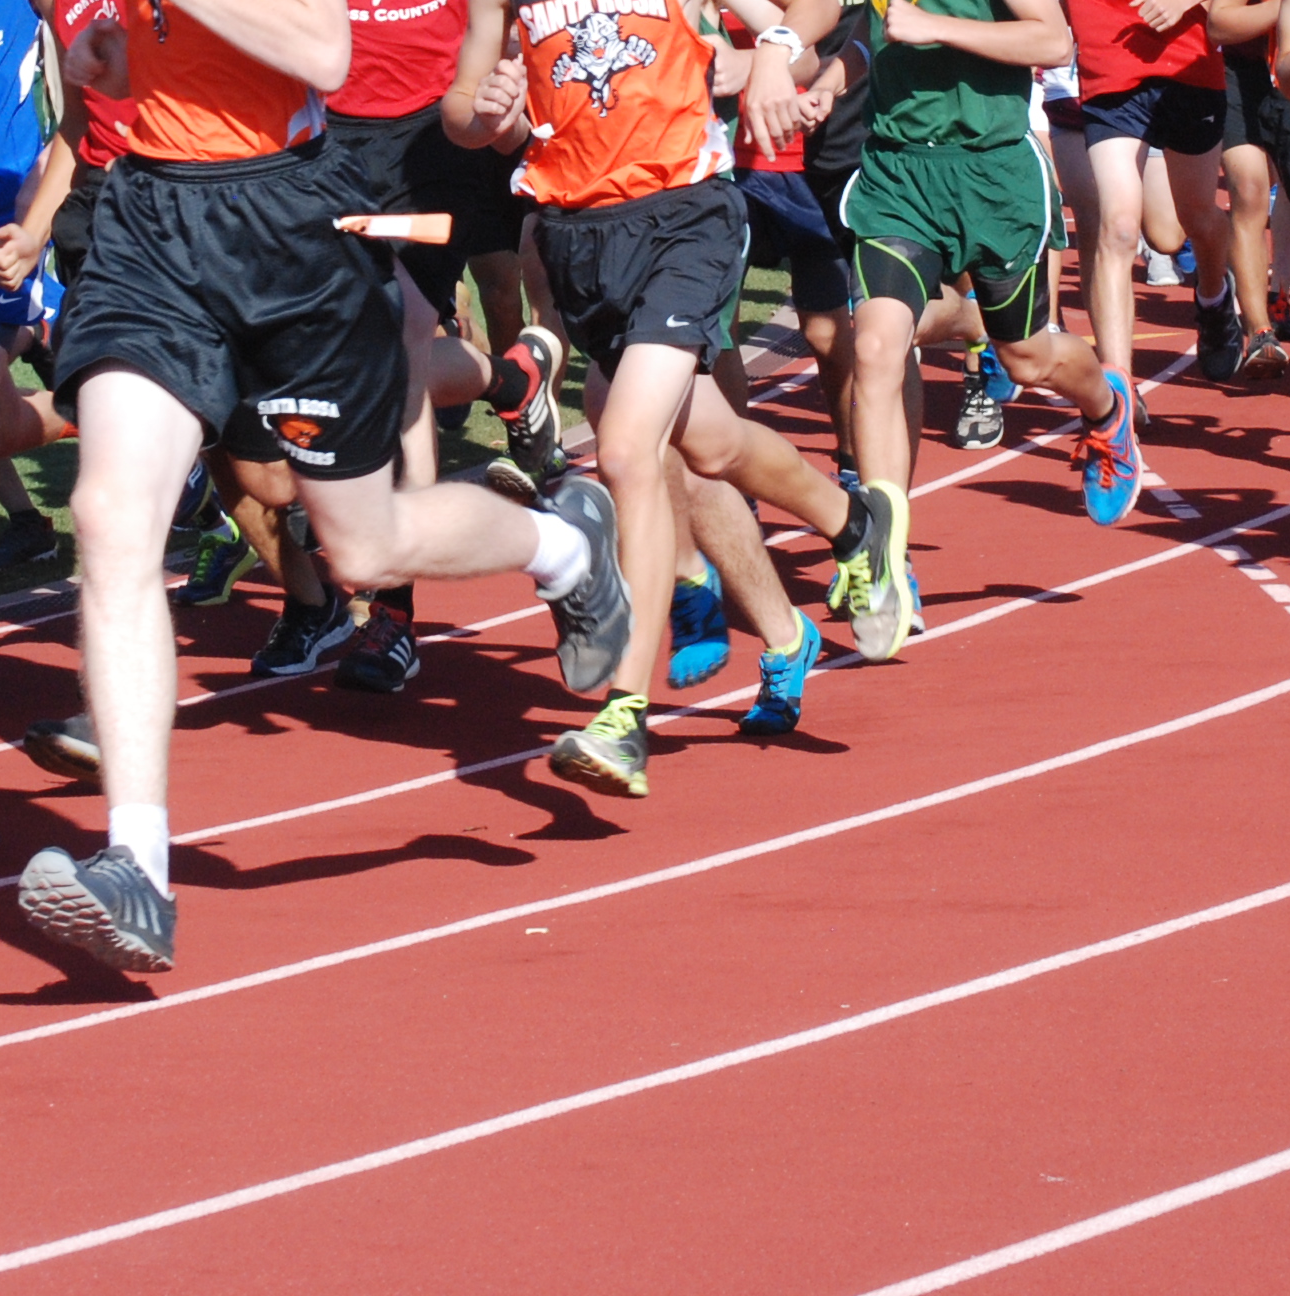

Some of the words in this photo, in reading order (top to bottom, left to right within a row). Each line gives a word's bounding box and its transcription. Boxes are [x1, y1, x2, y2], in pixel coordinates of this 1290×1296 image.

[347, 8, 369, 21] SS
[257, 397, 297, 415] SANTA
[298, 398, 340, 418] ROSA
